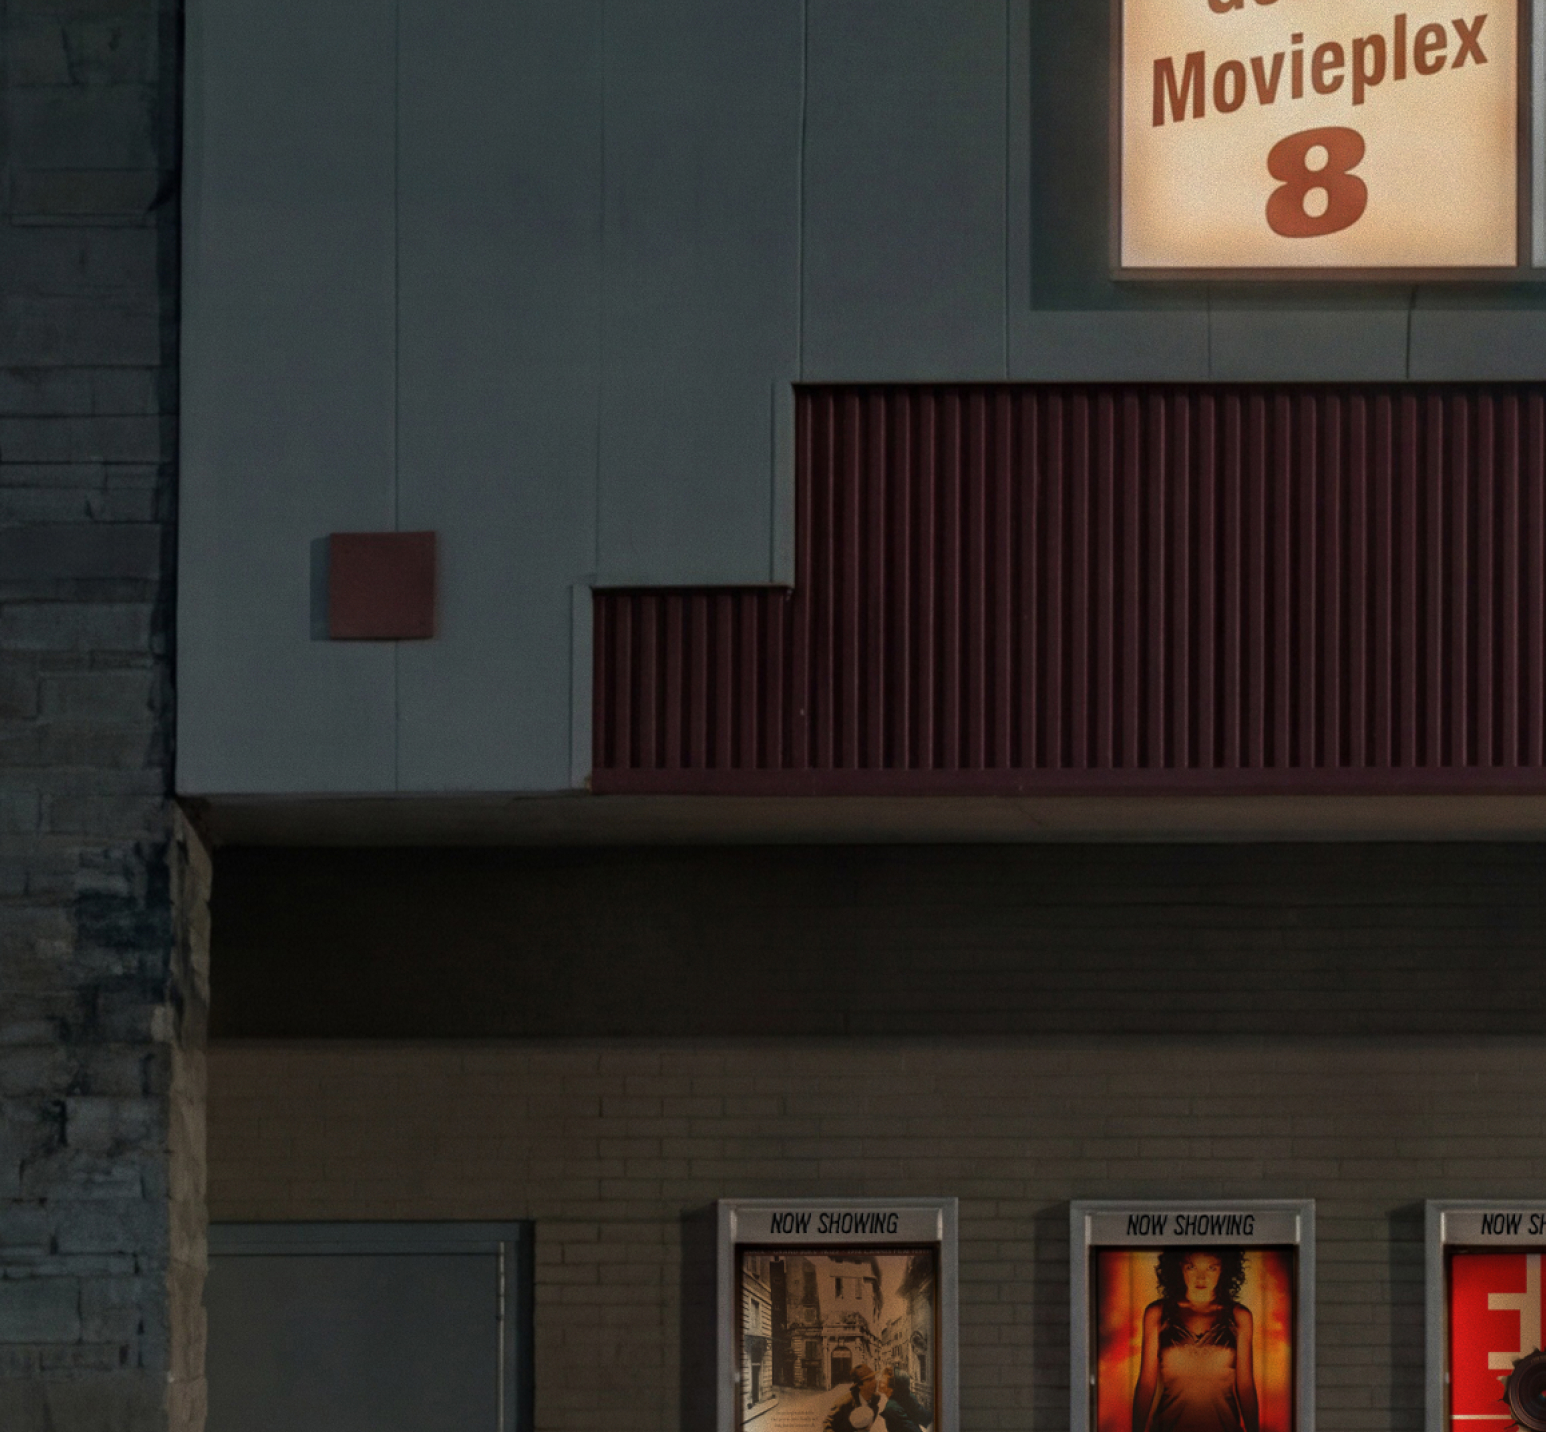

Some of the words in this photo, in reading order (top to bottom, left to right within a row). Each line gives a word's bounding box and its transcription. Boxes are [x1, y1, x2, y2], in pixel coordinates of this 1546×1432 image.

[1152, 13, 1489, 127] Movieplex
[1265, 126, 1368, 239] 8
[771, 1212, 811, 1234] NOW
[818, 1212, 899, 1234] SHOWING
[1127, 1214, 1167, 1236] NOW
[1173, 1214, 1255, 1236] SHOWING
[1481, 1213, 1522, 1235] NOW
